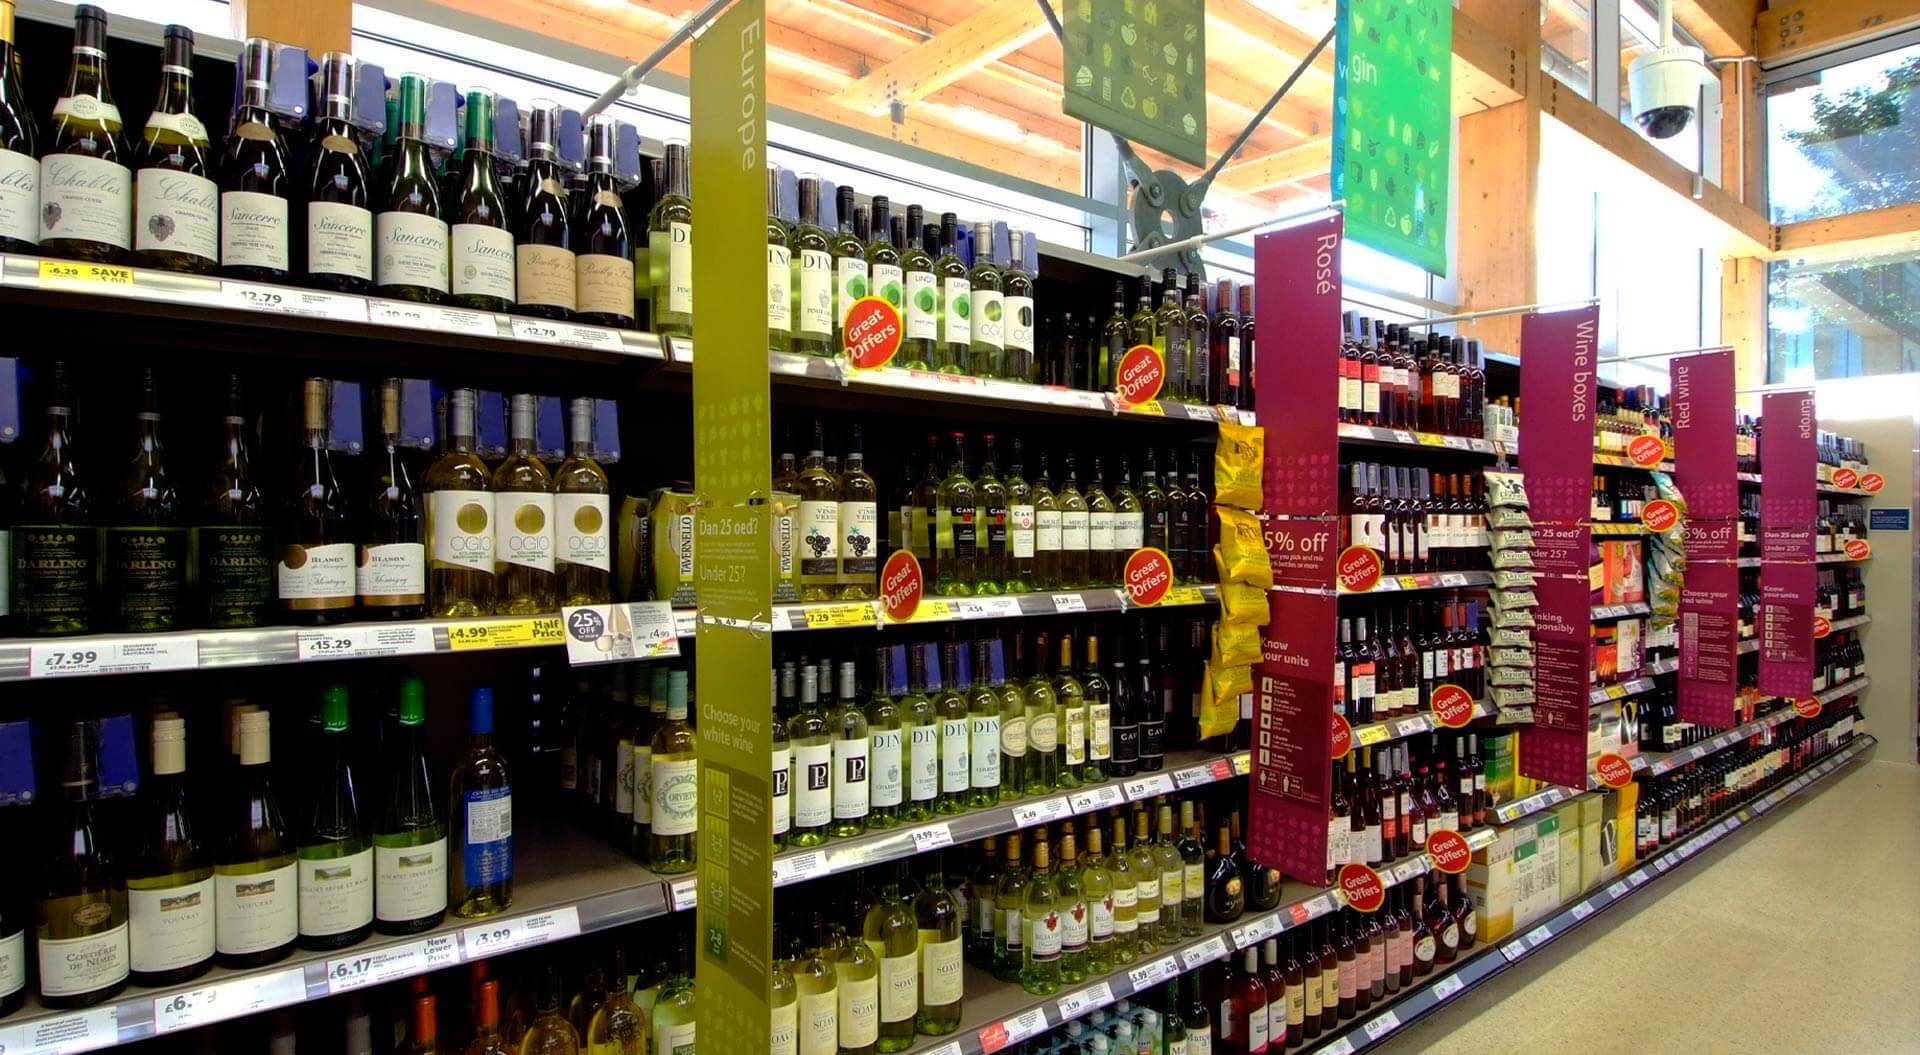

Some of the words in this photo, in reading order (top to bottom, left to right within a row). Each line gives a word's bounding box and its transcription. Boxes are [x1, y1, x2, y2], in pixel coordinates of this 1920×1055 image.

[736, 18, 759, 172] Europe
[49, 162, 121, 195] Chablis
[226, 207, 281, 226] Sancerre
[314, 216, 367, 236] Sancerre
[386, 226, 445, 249] Sancerre
[91, 267, 129, 279] SAVE
[1316, 233, 1337, 295] Rosé
[848, 308, 885, 342] Great
[855, 321, 896, 360] Offers
[1575, 320, 1594, 366] Wine
[1123, 355, 1152, 382] Great
[1128, 367, 1160, 396] Offers
[1675, 366, 1689, 398] wine
[1573, 372, 1592, 422] boxes
[1676, 402, 1690, 429] Red
[1798, 399, 1815, 439] Europe
[1646, 505, 1669, 519] Great
[700, 520, 718, 536] Dan
[720, 519, 731, 536] 25
[734, 518, 758, 535] oed?
[1542, 529, 1554, 538] 25
[1557, 529, 1580, 539] oed?
[1711, 527, 1732, 540] off
[681, 516, 693, 575] TAVERNELLO
[782, 516, 792, 572] TAVERNELLO
[1301, 533, 1329, 552] off
[18, 558, 87, 569] DARLING
[210, 557, 268, 568] DARLING
[1343, 554, 1369, 573] Great
[1530, 550, 1549, 559] nder
[1551, 550, 1567, 559] 25?
[119, 560, 176, 570] ARLING
[700, 564, 726, 582] Under
[729, 566, 745, 583] 25?
[1130, 558, 1159, 582] Great
[886, 562, 912, 591] Great
[1133, 570, 1167, 597] Offers
[1348, 564, 1377, 585] Offers
[889, 578, 918, 609] Offers
[1682, 590, 1709, 599] Choose
[1710, 591, 1728, 600] your
[534, 619, 559, 629] Half
[573, 613, 601, 628] 25%
[1532, 613, 1562, 624] inking
[450, 627, 487, 639] £4.99
[532, 629, 563, 638] Price
[579, 627, 595, 635] OFF
[650, 629, 669, 638] £4.99
[310, 639, 352, 650] £15.29
[45, 651, 97, 665] £7.99
[1284, 655, 1309, 668] units
[1437, 692, 1461, 709] Great
[703, 704, 739, 726] Choose
[741, 716, 761, 735] your
[1442, 701, 1470, 721] Offers
[703, 727, 731, 748] white
[732, 736, 753, 755] wine
[1601, 759, 1623, 773] Great
[1607, 766, 1630, 781] Offers
[1432, 838, 1458, 852] Great
[1437, 849, 1467, 865] Offers
[1345, 873, 1371, 888] Great
[1351, 885, 1380, 901] Offers
[427, 938, 447, 947] New
[475, 928, 511, 947] £3.99
[710, 929, 722, 946] 7-8
[424, 944, 452, 956] Lower
[427, 953, 450, 963] Price
[330, 958, 372, 980] £6.17
